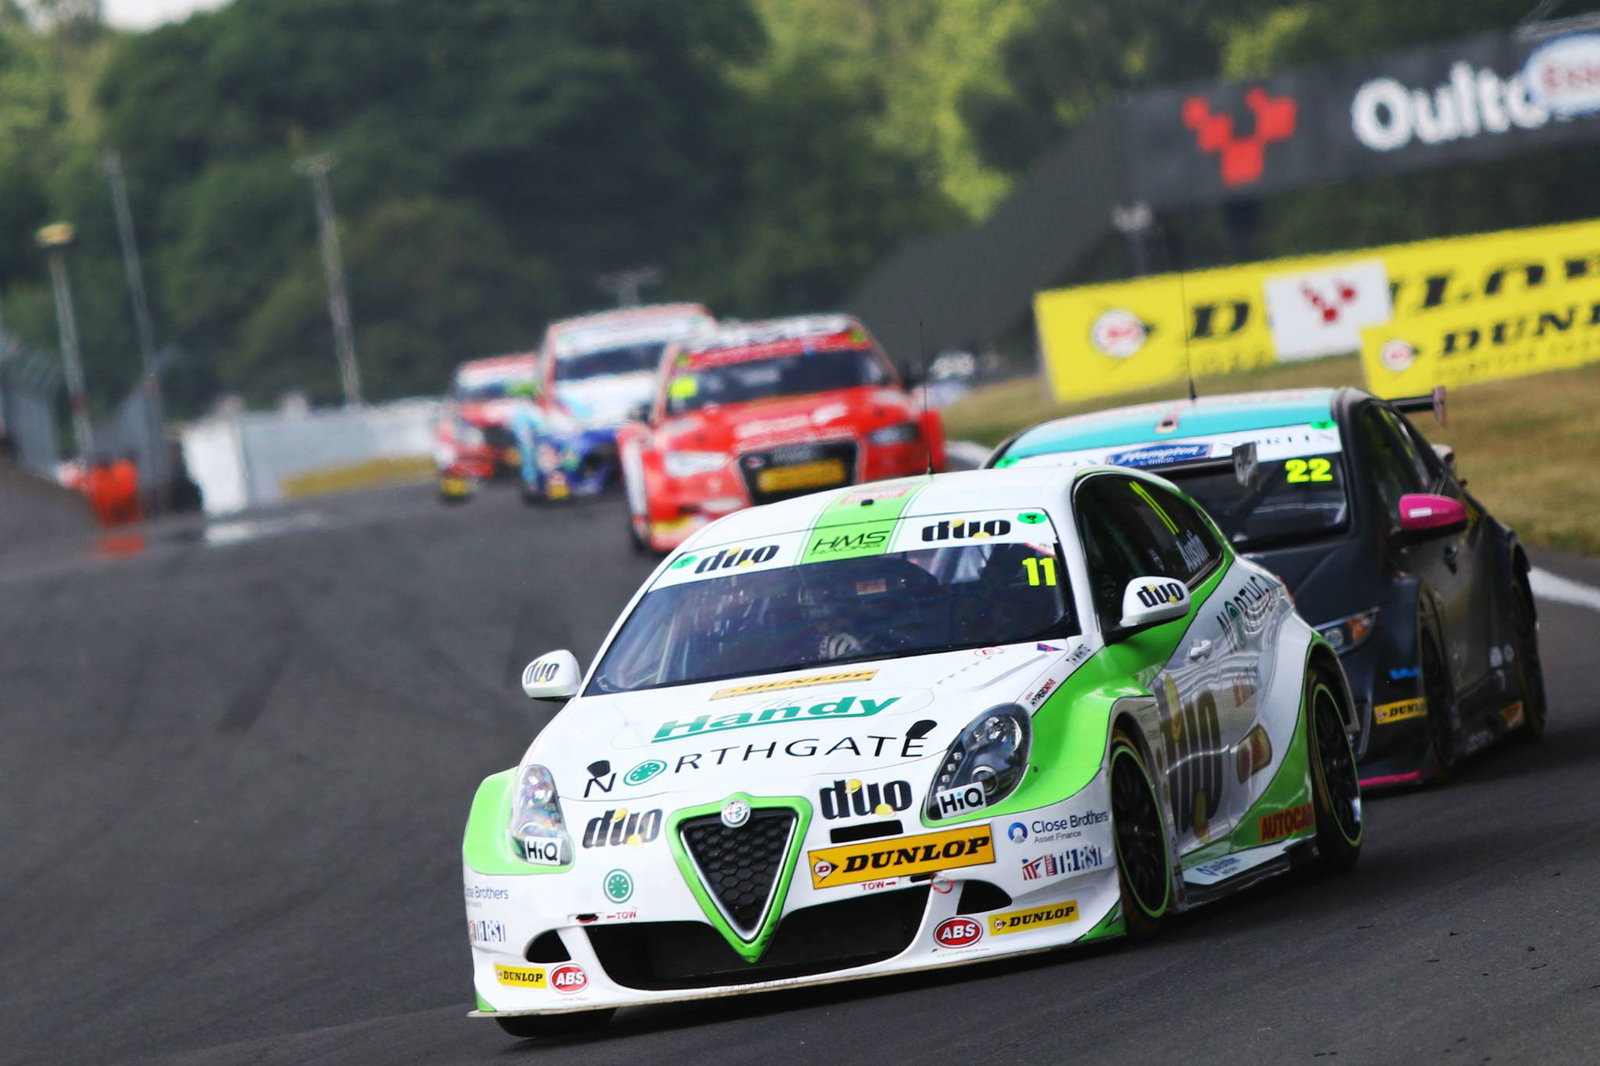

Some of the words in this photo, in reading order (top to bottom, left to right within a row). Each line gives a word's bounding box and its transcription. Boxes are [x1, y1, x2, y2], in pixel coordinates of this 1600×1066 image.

[1352, 61, 1551, 152] Oulto
[1285, 457, 1333, 484] 22
[813, 530, 890, 551] HMS
[922, 520, 1011, 543] duo
[694, 545, 780, 575] duo
[1022, 557, 1057, 587] 11
[1137, 582, 1184, 608] duo
[526, 661, 560, 685] duo
[651, 696, 902, 744] Handy
[820, 779, 912, 819] duo
[939, 787, 984, 814] HiQ
[583, 808, 663, 849] duo
[1032, 819, 1068, 834] Close
[1069, 809, 1110, 829] Brothers
[1260, 803, 1314, 843] AUTOCA
[1034, 833, 1055, 843] Asset
[1055, 830, 1082, 841] Finance
[526, 840, 559, 863] HiQ
[843, 835, 990, 874] DUNLOP
[861, 881, 885, 891] TOW
[616, 910, 637, 919] TOW
[1008, 905, 1075, 928] DUNLOP
[940, 924, 976, 941] ABS
[502, 970, 544, 984] DUNLOP
[555, 972, 586, 986] ABS
